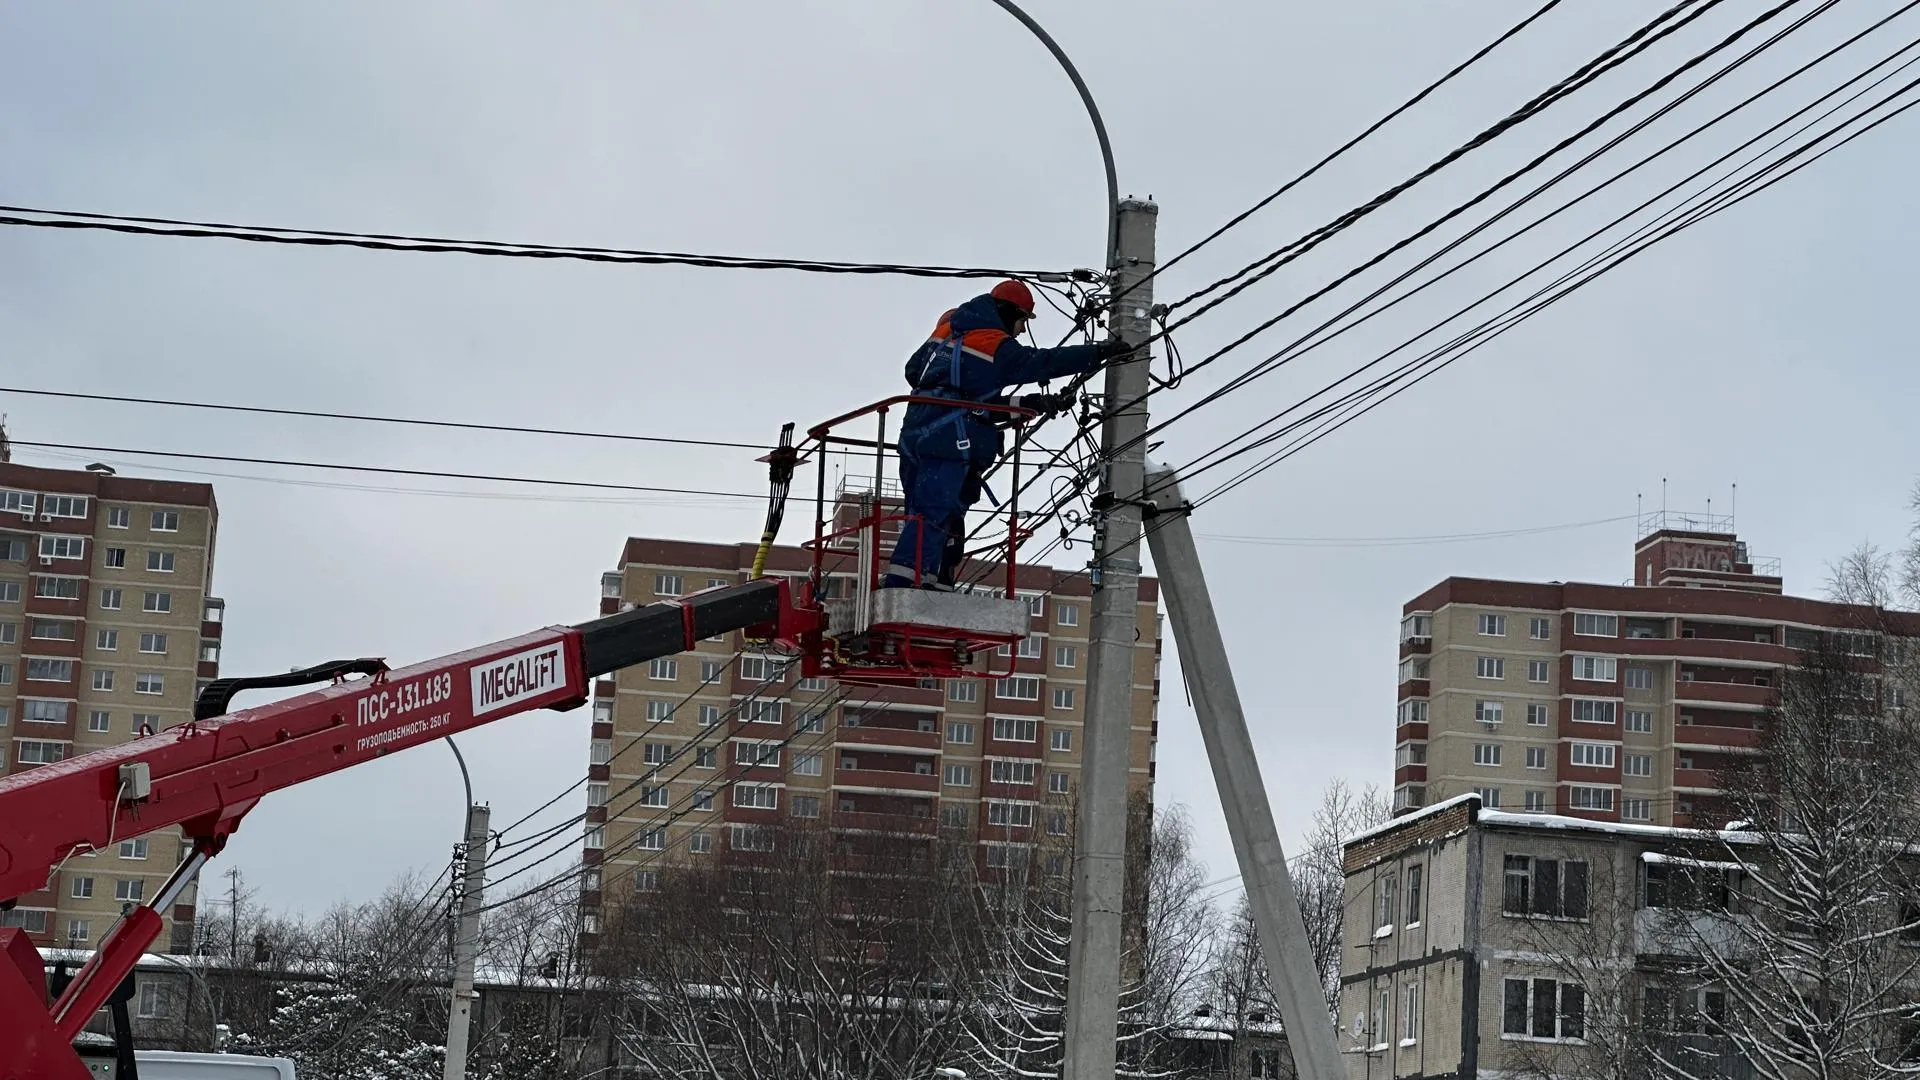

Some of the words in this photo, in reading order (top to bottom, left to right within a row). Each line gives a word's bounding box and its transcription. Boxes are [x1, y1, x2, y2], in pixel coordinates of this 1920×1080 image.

[357, 672, 451, 727] ПСС-131.18Э
[480, 649, 558, 706] MEGALIFT
[357, 720, 429, 751] ГРУЗОПОДЪЕМНОСТЬ:
[430, 715, 441, 729] 250
[442, 712, 451, 725] КГ
